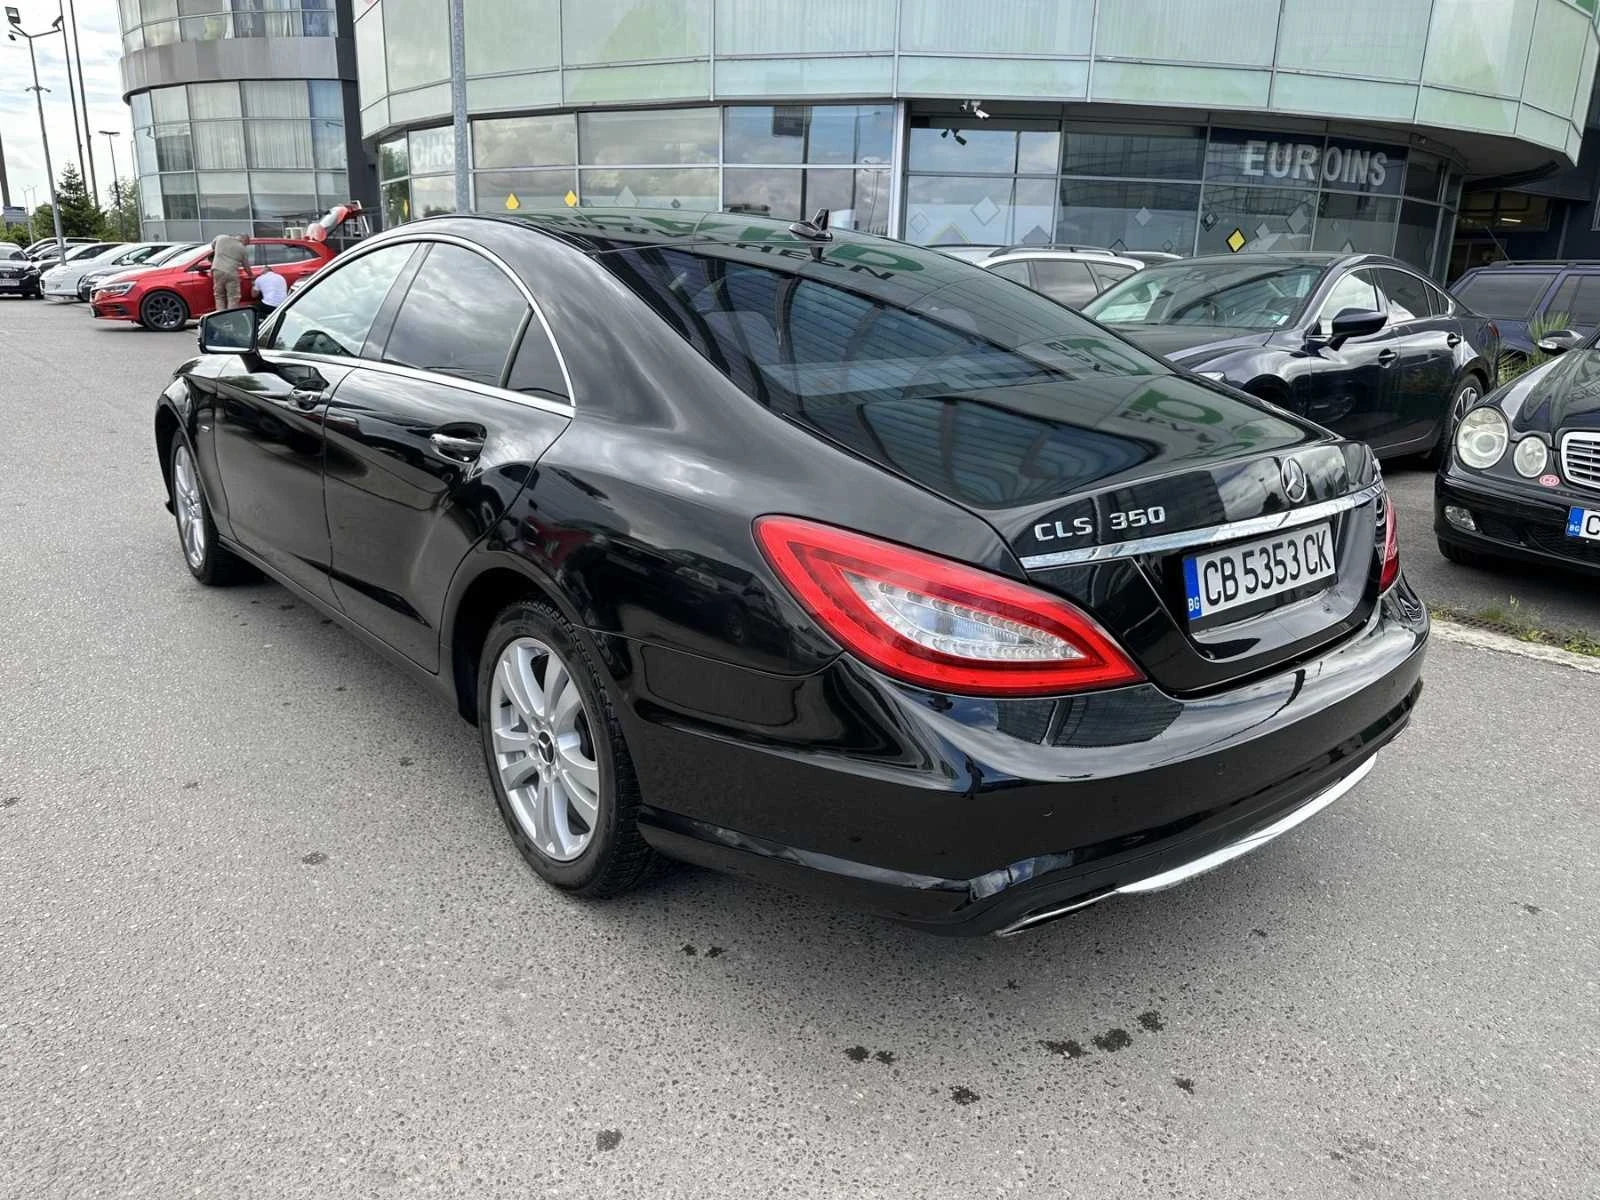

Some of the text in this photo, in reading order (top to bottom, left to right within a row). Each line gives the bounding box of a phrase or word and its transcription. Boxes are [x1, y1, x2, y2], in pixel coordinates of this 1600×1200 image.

[1242, 140, 1388, 186] EUROINS
[1034, 506, 1165, 541] CLS 350
[1569, 524, 1581, 532] BG
[1188, 597, 1200, 611] BG
